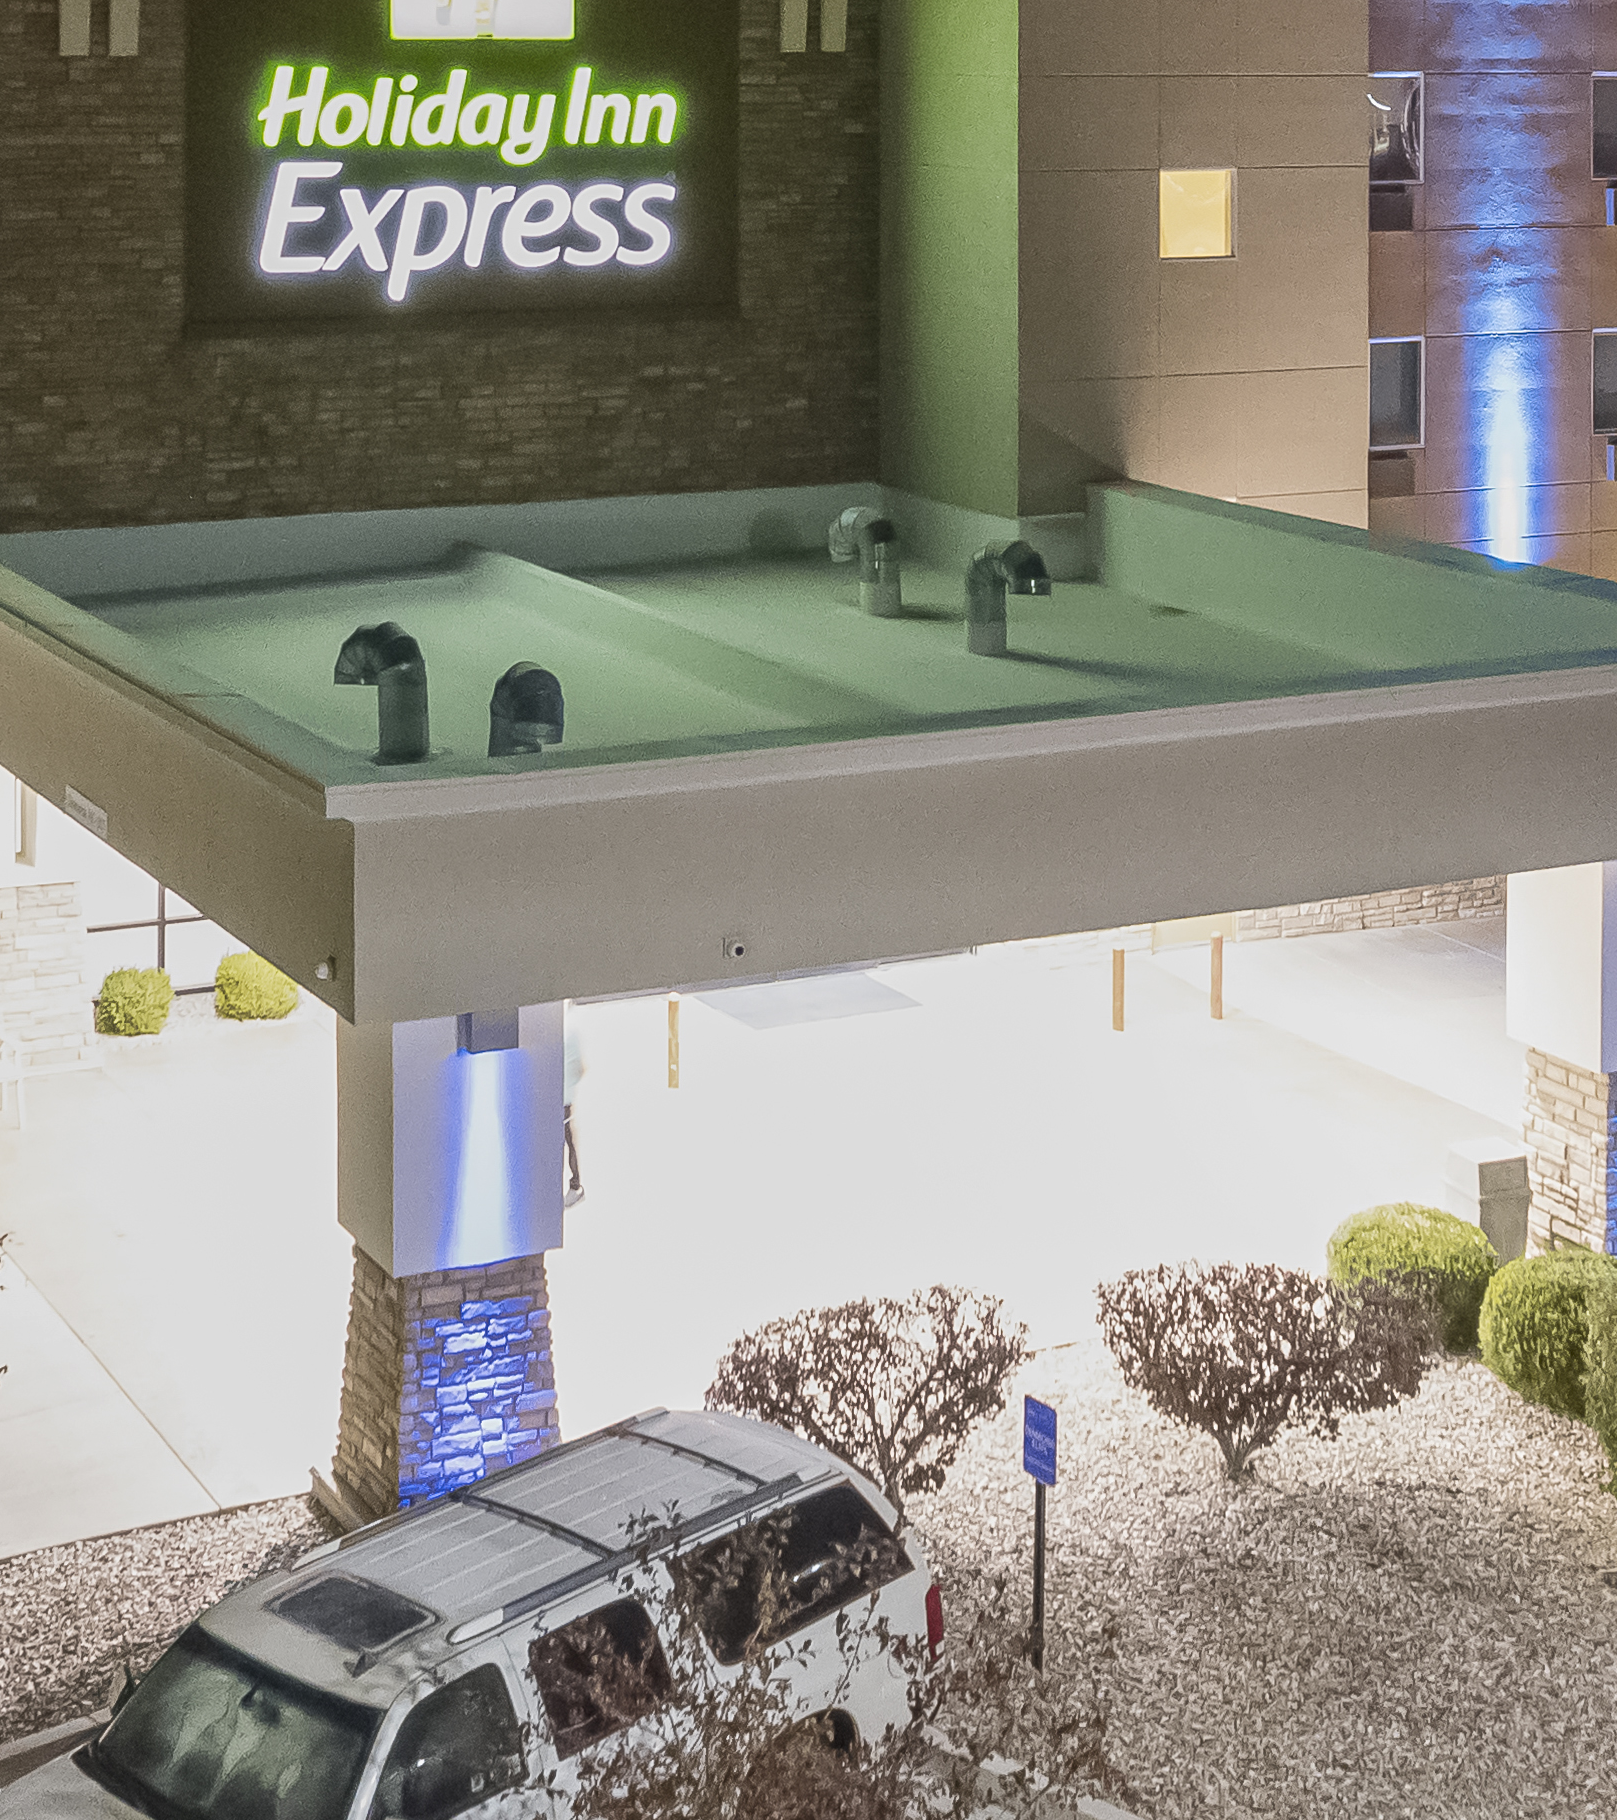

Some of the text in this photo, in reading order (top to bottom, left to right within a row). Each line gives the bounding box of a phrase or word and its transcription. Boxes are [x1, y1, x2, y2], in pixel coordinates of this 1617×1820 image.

[256, 64, 679, 167] Holiday Inn
[258, 160, 678, 303] Express
